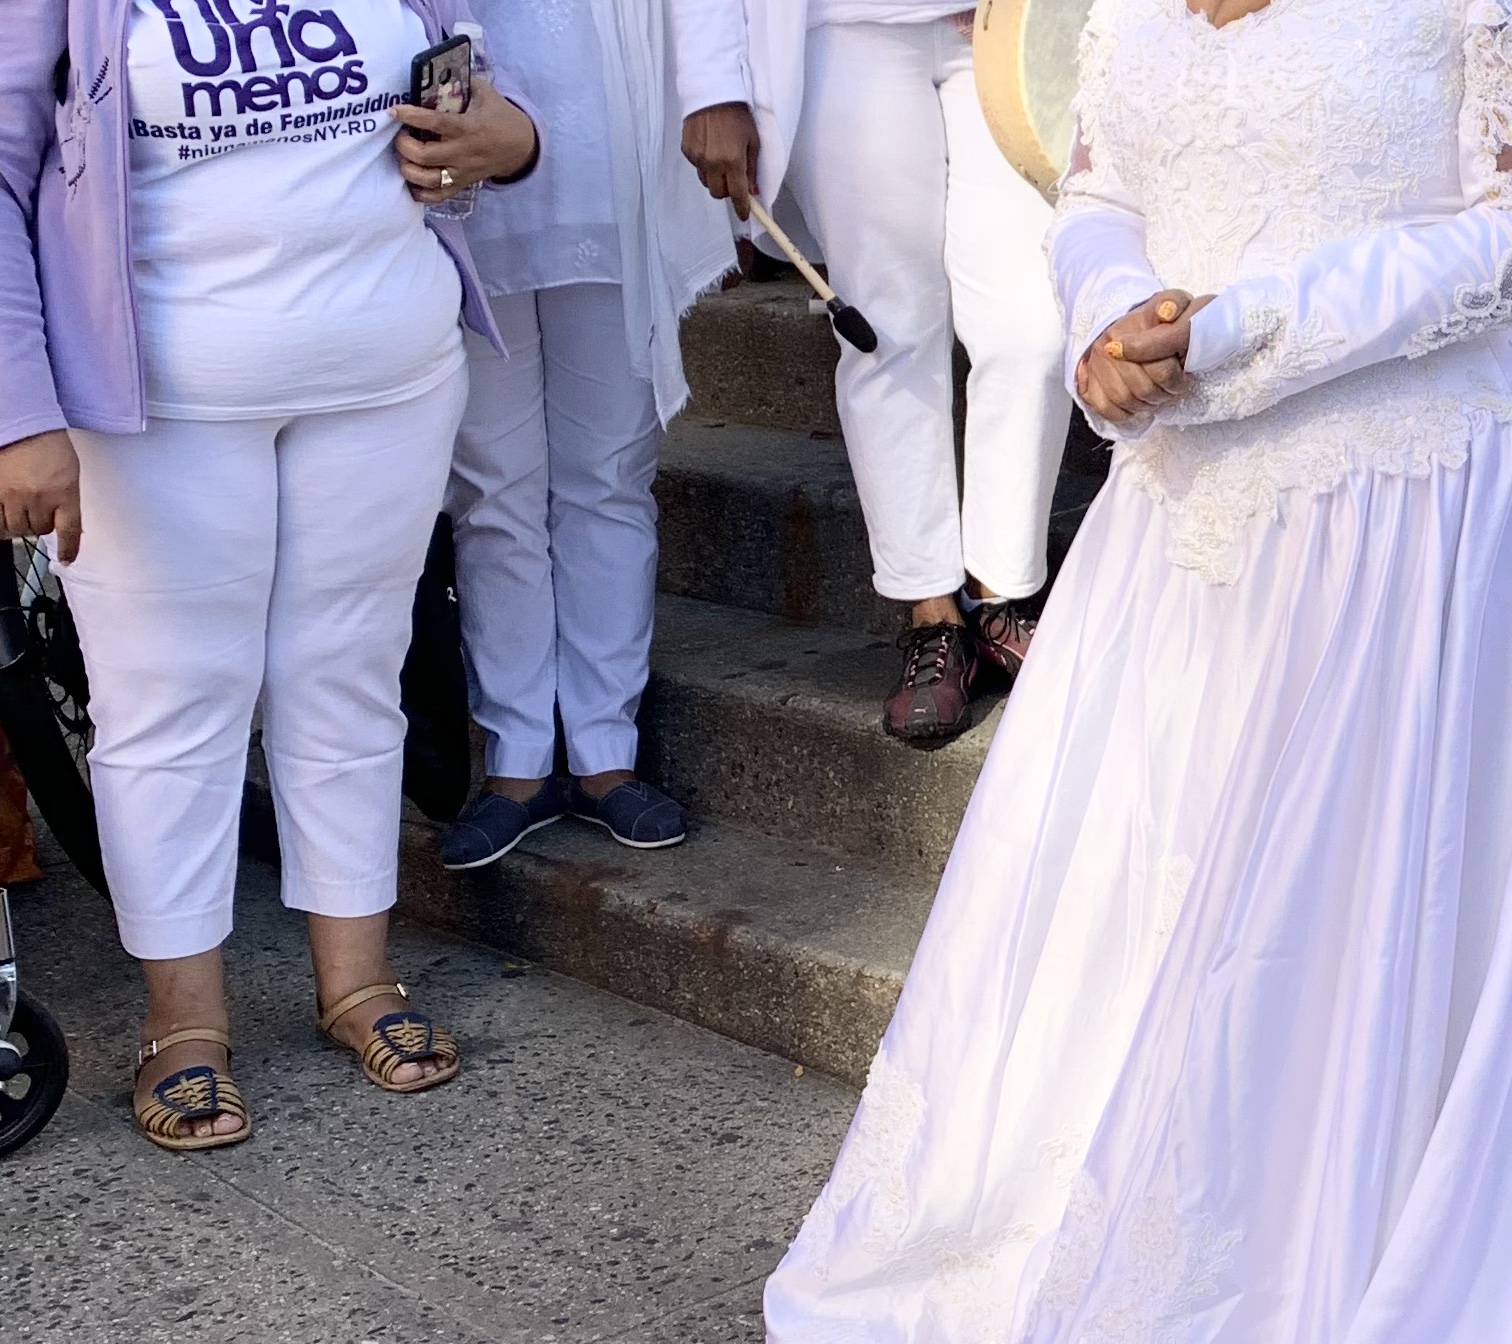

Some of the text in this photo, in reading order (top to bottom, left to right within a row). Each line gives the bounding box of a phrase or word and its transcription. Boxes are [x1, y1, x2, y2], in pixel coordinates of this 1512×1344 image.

[166, 8, 358, 77] una
[181, 59, 368, 117] menos
[209, 122, 237, 142] ya
[246, 119, 273, 137] de
[280, 91, 411, 132] Feminicidios
